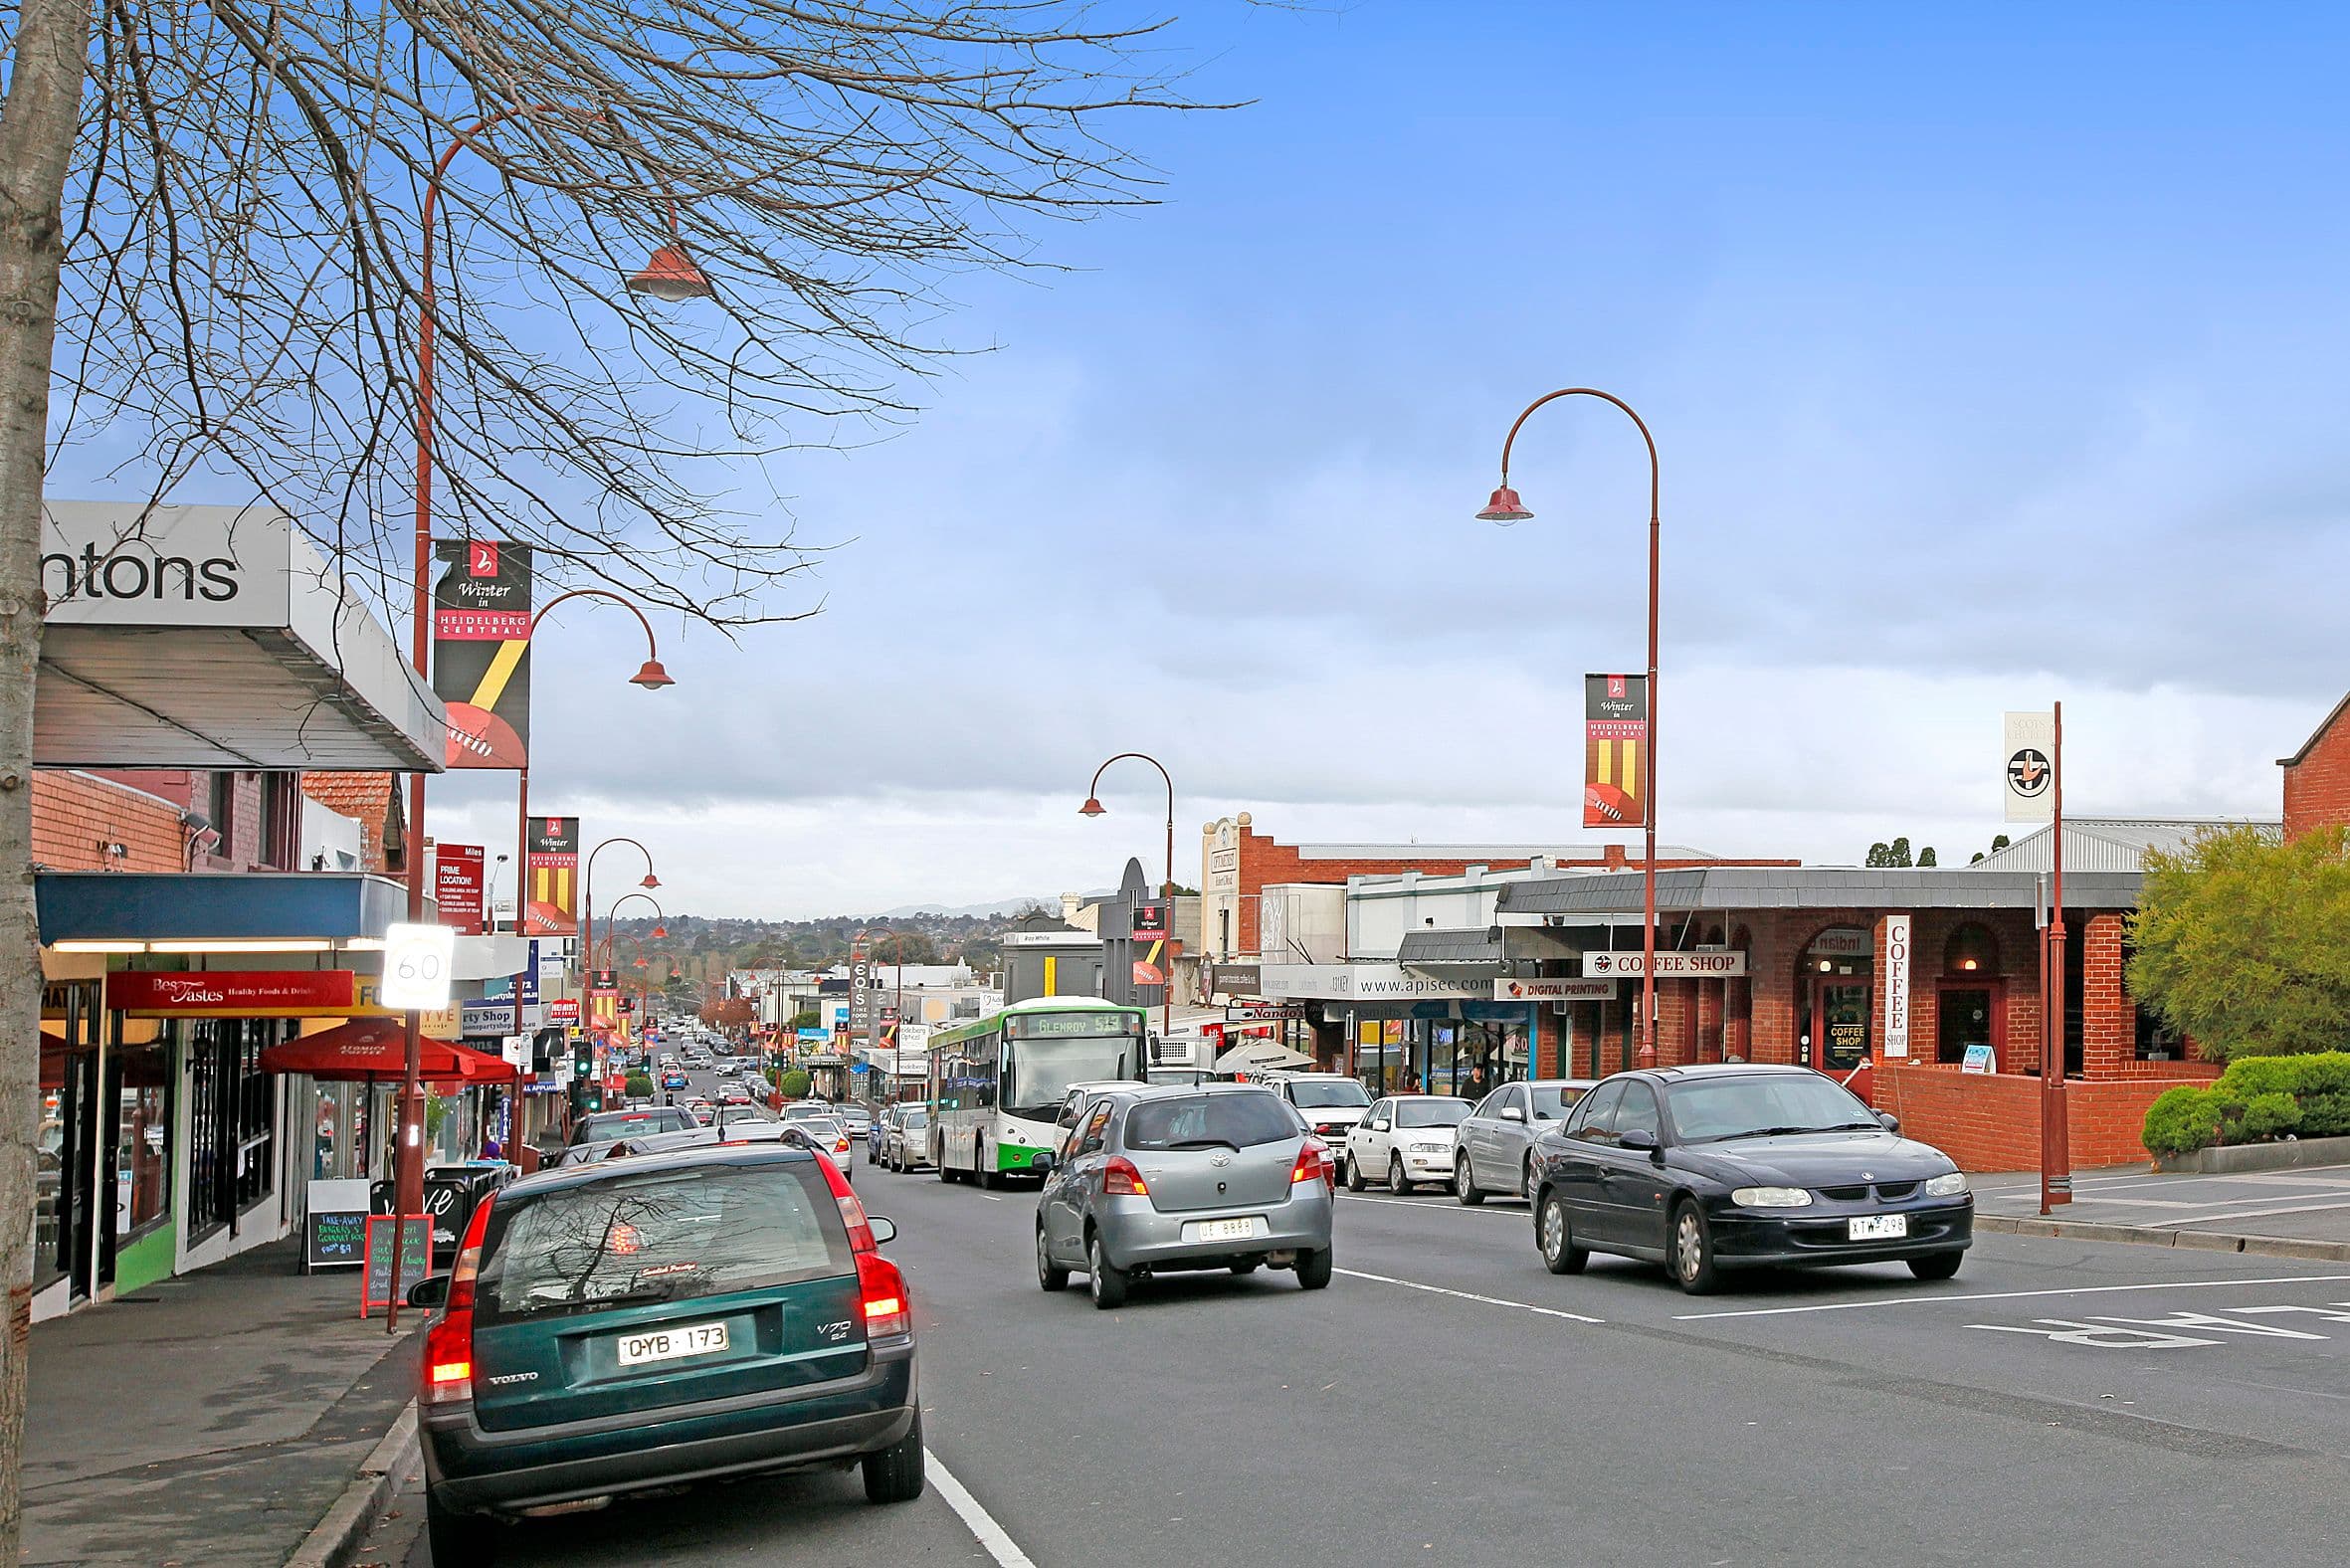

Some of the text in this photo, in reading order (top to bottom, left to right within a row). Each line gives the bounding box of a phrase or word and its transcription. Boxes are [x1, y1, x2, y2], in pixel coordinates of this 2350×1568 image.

[458, 581, 511, 597] Winter
[478, 597, 489, 607] in
[441, 616, 526, 626] HEIDELBERG
[443, 626, 521, 635] CENTRAL
[1600, 699, 1635, 711] Winter
[465, 847, 483, 857] Miles
[440, 866, 461, 876] PRIME
[440, 876, 473, 885] LOCATION!
[398, 954, 440, 980] 60
[1618, 956, 1736, 972] COFEE SHOP
[1889, 925, 1905, 1030] COFFEE
[1360, 977, 1494, 995] www.apisec.com
[1527, 982, 1609, 996] DIGITAL PRINTING
[228, 988, 257, 997] Healthy
[483, 1010, 510, 1023] Shop
[1253, 1008, 1305, 1019] Nando's
[1039, 1019, 1086, 1034] GLENROY
[1831, 1027, 1864, 1037] COFFEE
[1836, 1037, 1861, 1046] SHOP
[1886, 1034, 1906, 1046] SHOP
[320, 1215, 363, 1226] TAKE-AWAY
[489, 1371, 539, 1386] VOLVO
